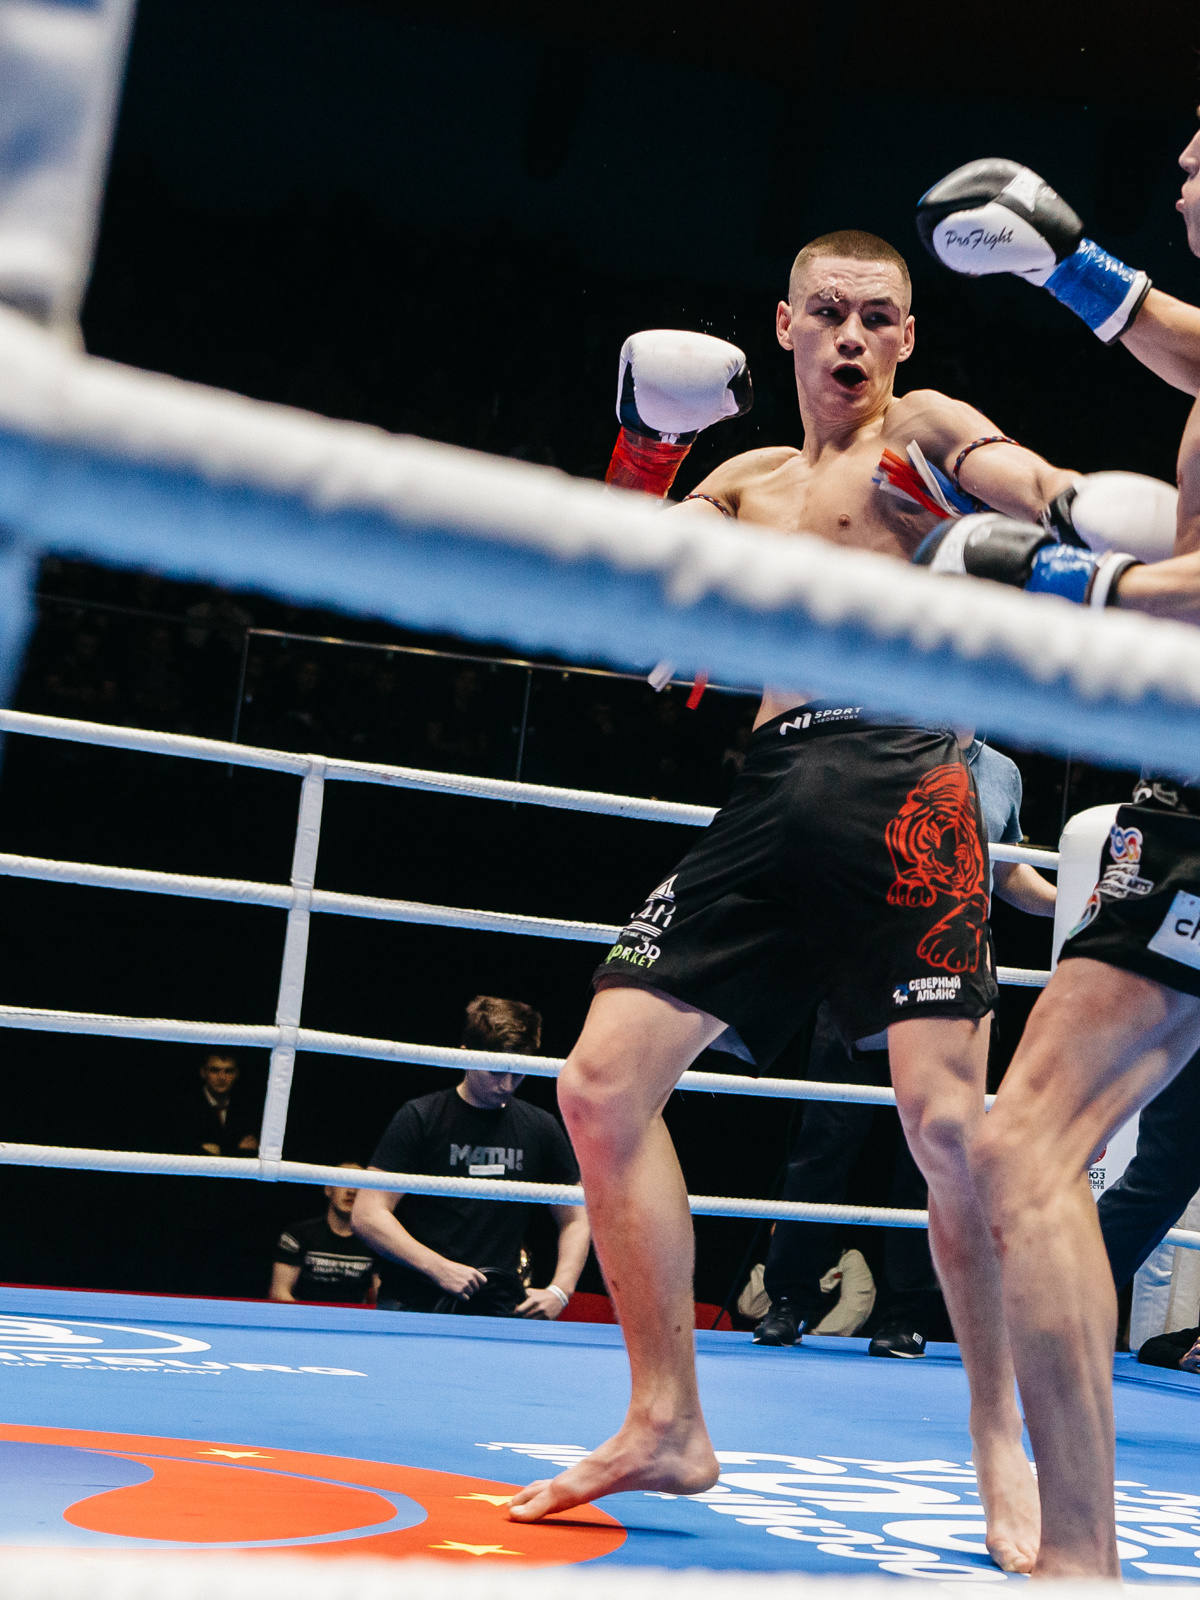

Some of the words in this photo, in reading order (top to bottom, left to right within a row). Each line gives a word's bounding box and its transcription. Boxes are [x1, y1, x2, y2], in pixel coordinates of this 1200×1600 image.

[944, 226, 1015, 251] ProFight
[814, 706, 863, 719] SPORT
[813, 714, 859, 725] LABORATORY
[909, 975, 962, 991] СЕВЕРНЫЙ
[917, 988, 956, 1002] АЛЬЯНС
[60, 1364, 223, 1376] COMPANY
